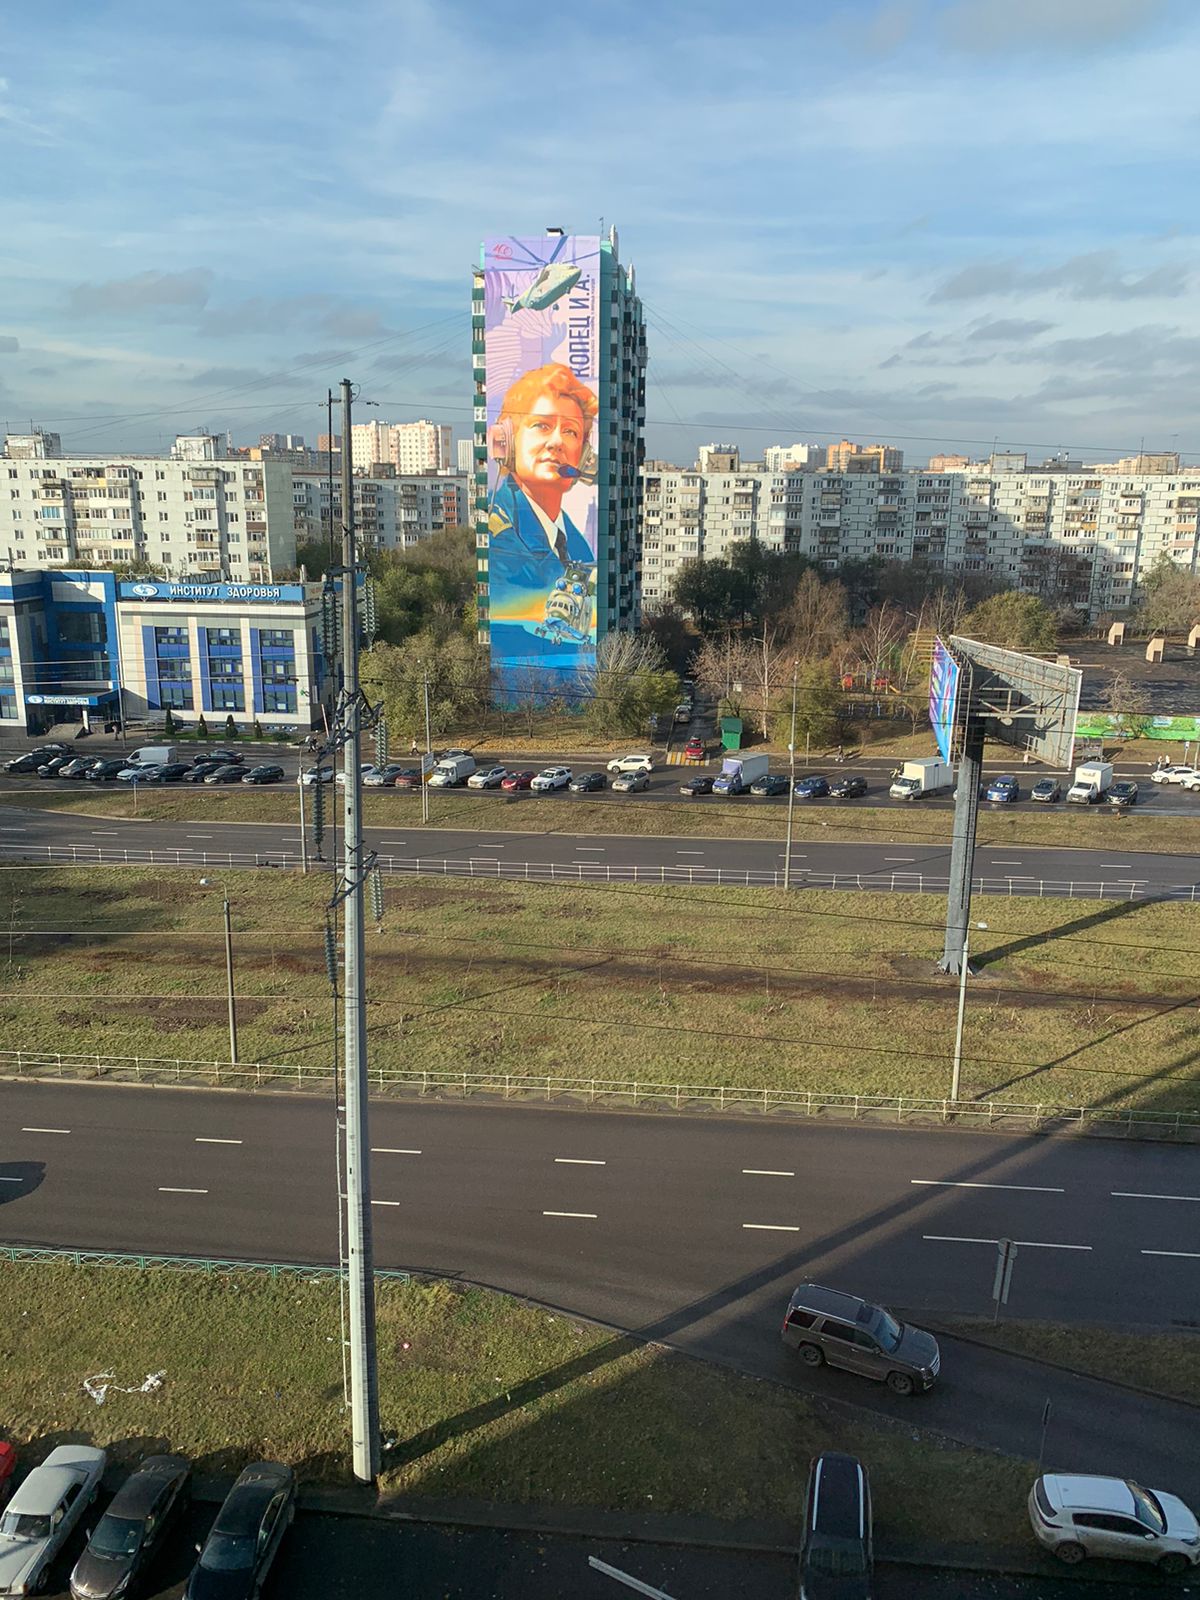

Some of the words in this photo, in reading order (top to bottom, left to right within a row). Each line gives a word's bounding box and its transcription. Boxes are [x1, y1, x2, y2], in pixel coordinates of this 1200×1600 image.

[569, 274, 590, 310] И.А.
[569, 316, 591, 378] КОПЕЦ
[169, 585, 220, 597] ИНСТИТУТ
[227, 586, 281, 598] ЗДОРОВЬЯ
